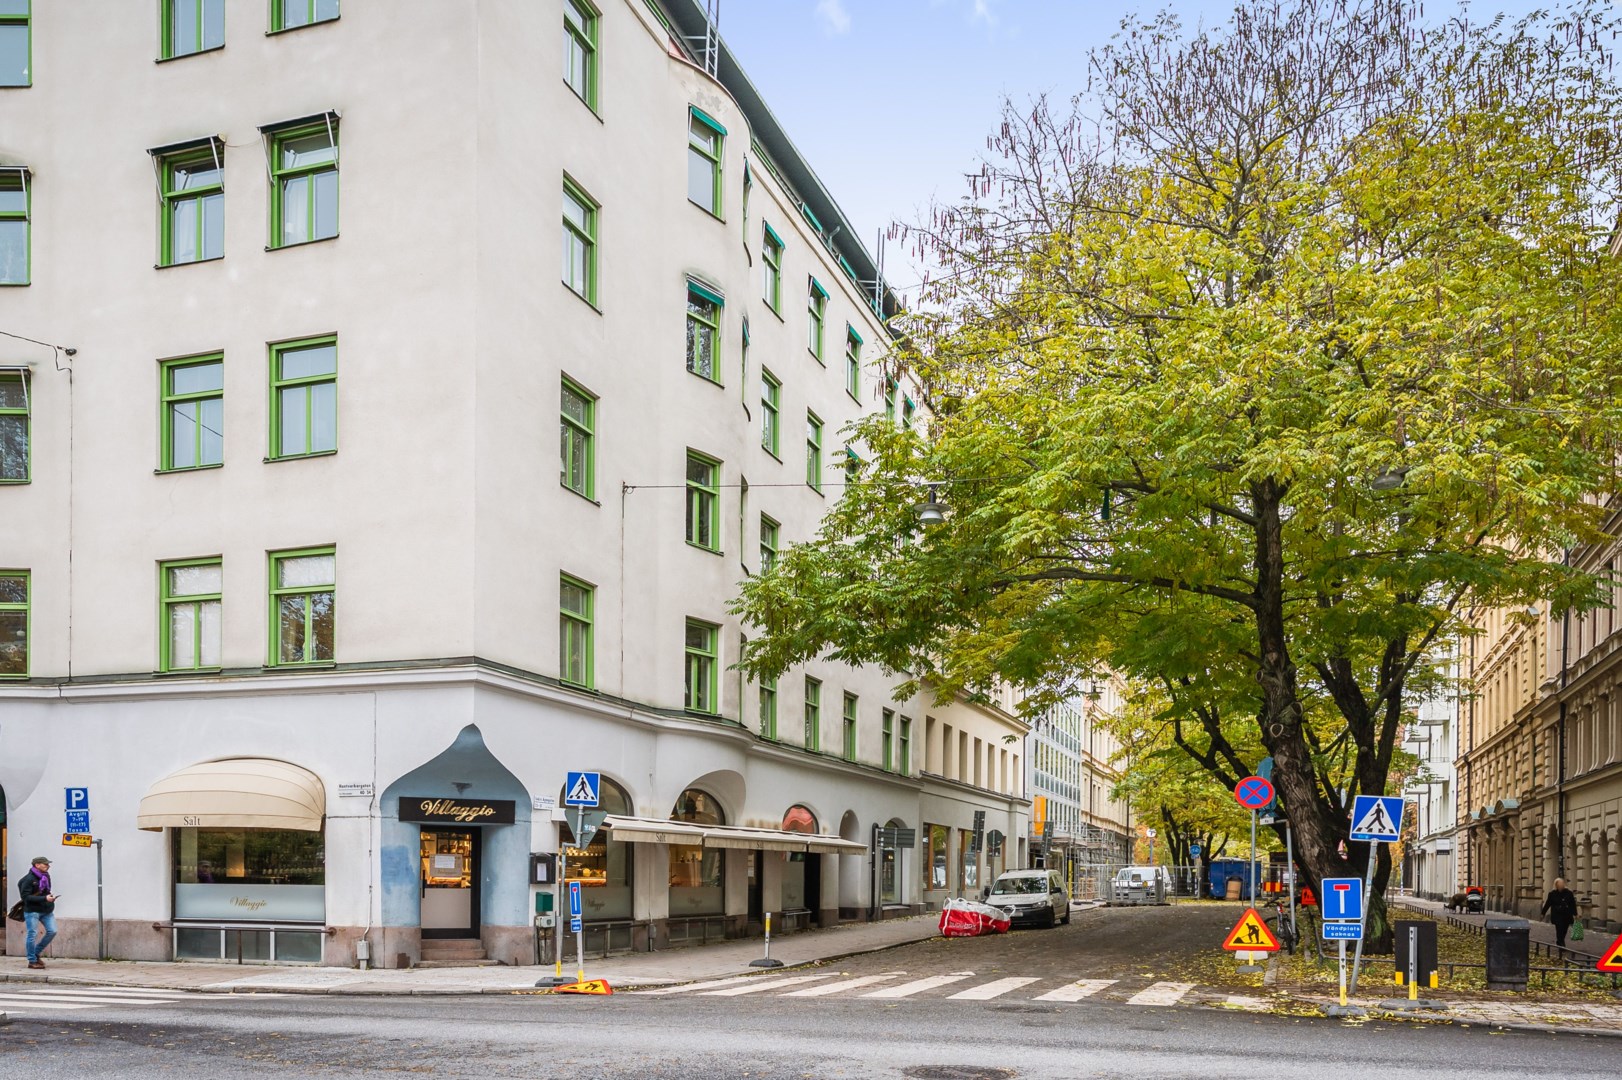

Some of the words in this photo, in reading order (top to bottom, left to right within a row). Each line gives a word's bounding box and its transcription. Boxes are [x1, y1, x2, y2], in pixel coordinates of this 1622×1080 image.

[71, 789, 85, 808] P
[420, 799, 497, 822] Villaggio
[183, 815, 201, 826] Salt
[230, 896, 268, 911] Villaggio
